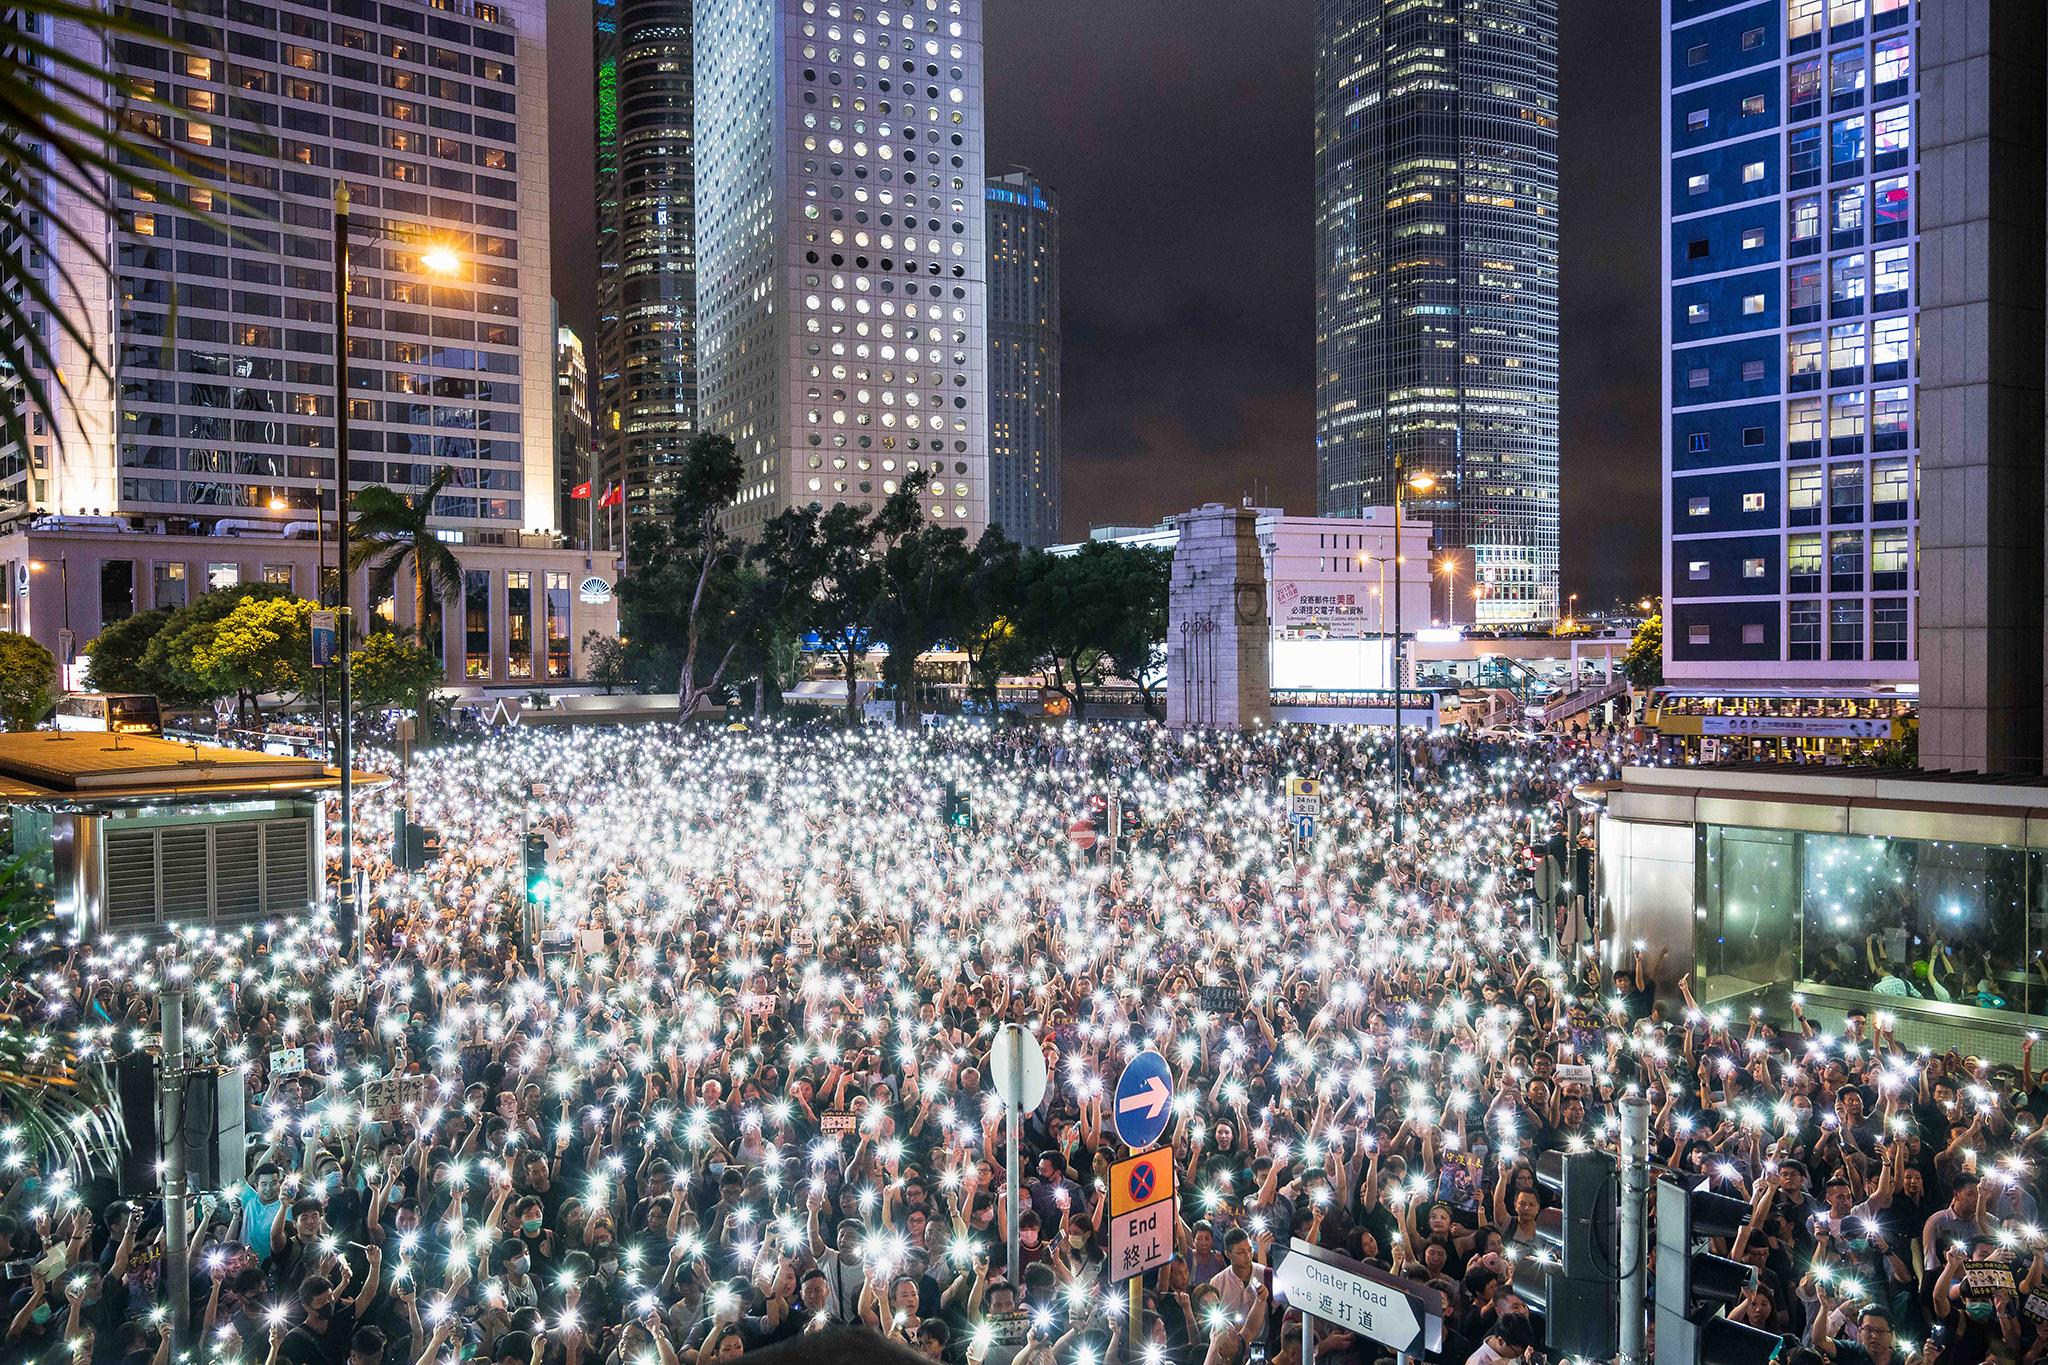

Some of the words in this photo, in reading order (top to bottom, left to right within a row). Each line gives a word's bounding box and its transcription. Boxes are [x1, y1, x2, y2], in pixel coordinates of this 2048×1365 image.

[1300, 594, 1355, 605] 投寄郵件往美國
[1299, 804, 1314, 812] 全日
[1129, 1212, 1157, 1237] End
[1123, 1237, 1162, 1271] 終止
[1305, 1265, 1348, 1292] Chater
[1352, 1281, 1387, 1307] Road
[1318, 1292, 1374, 1331] 遮打道
